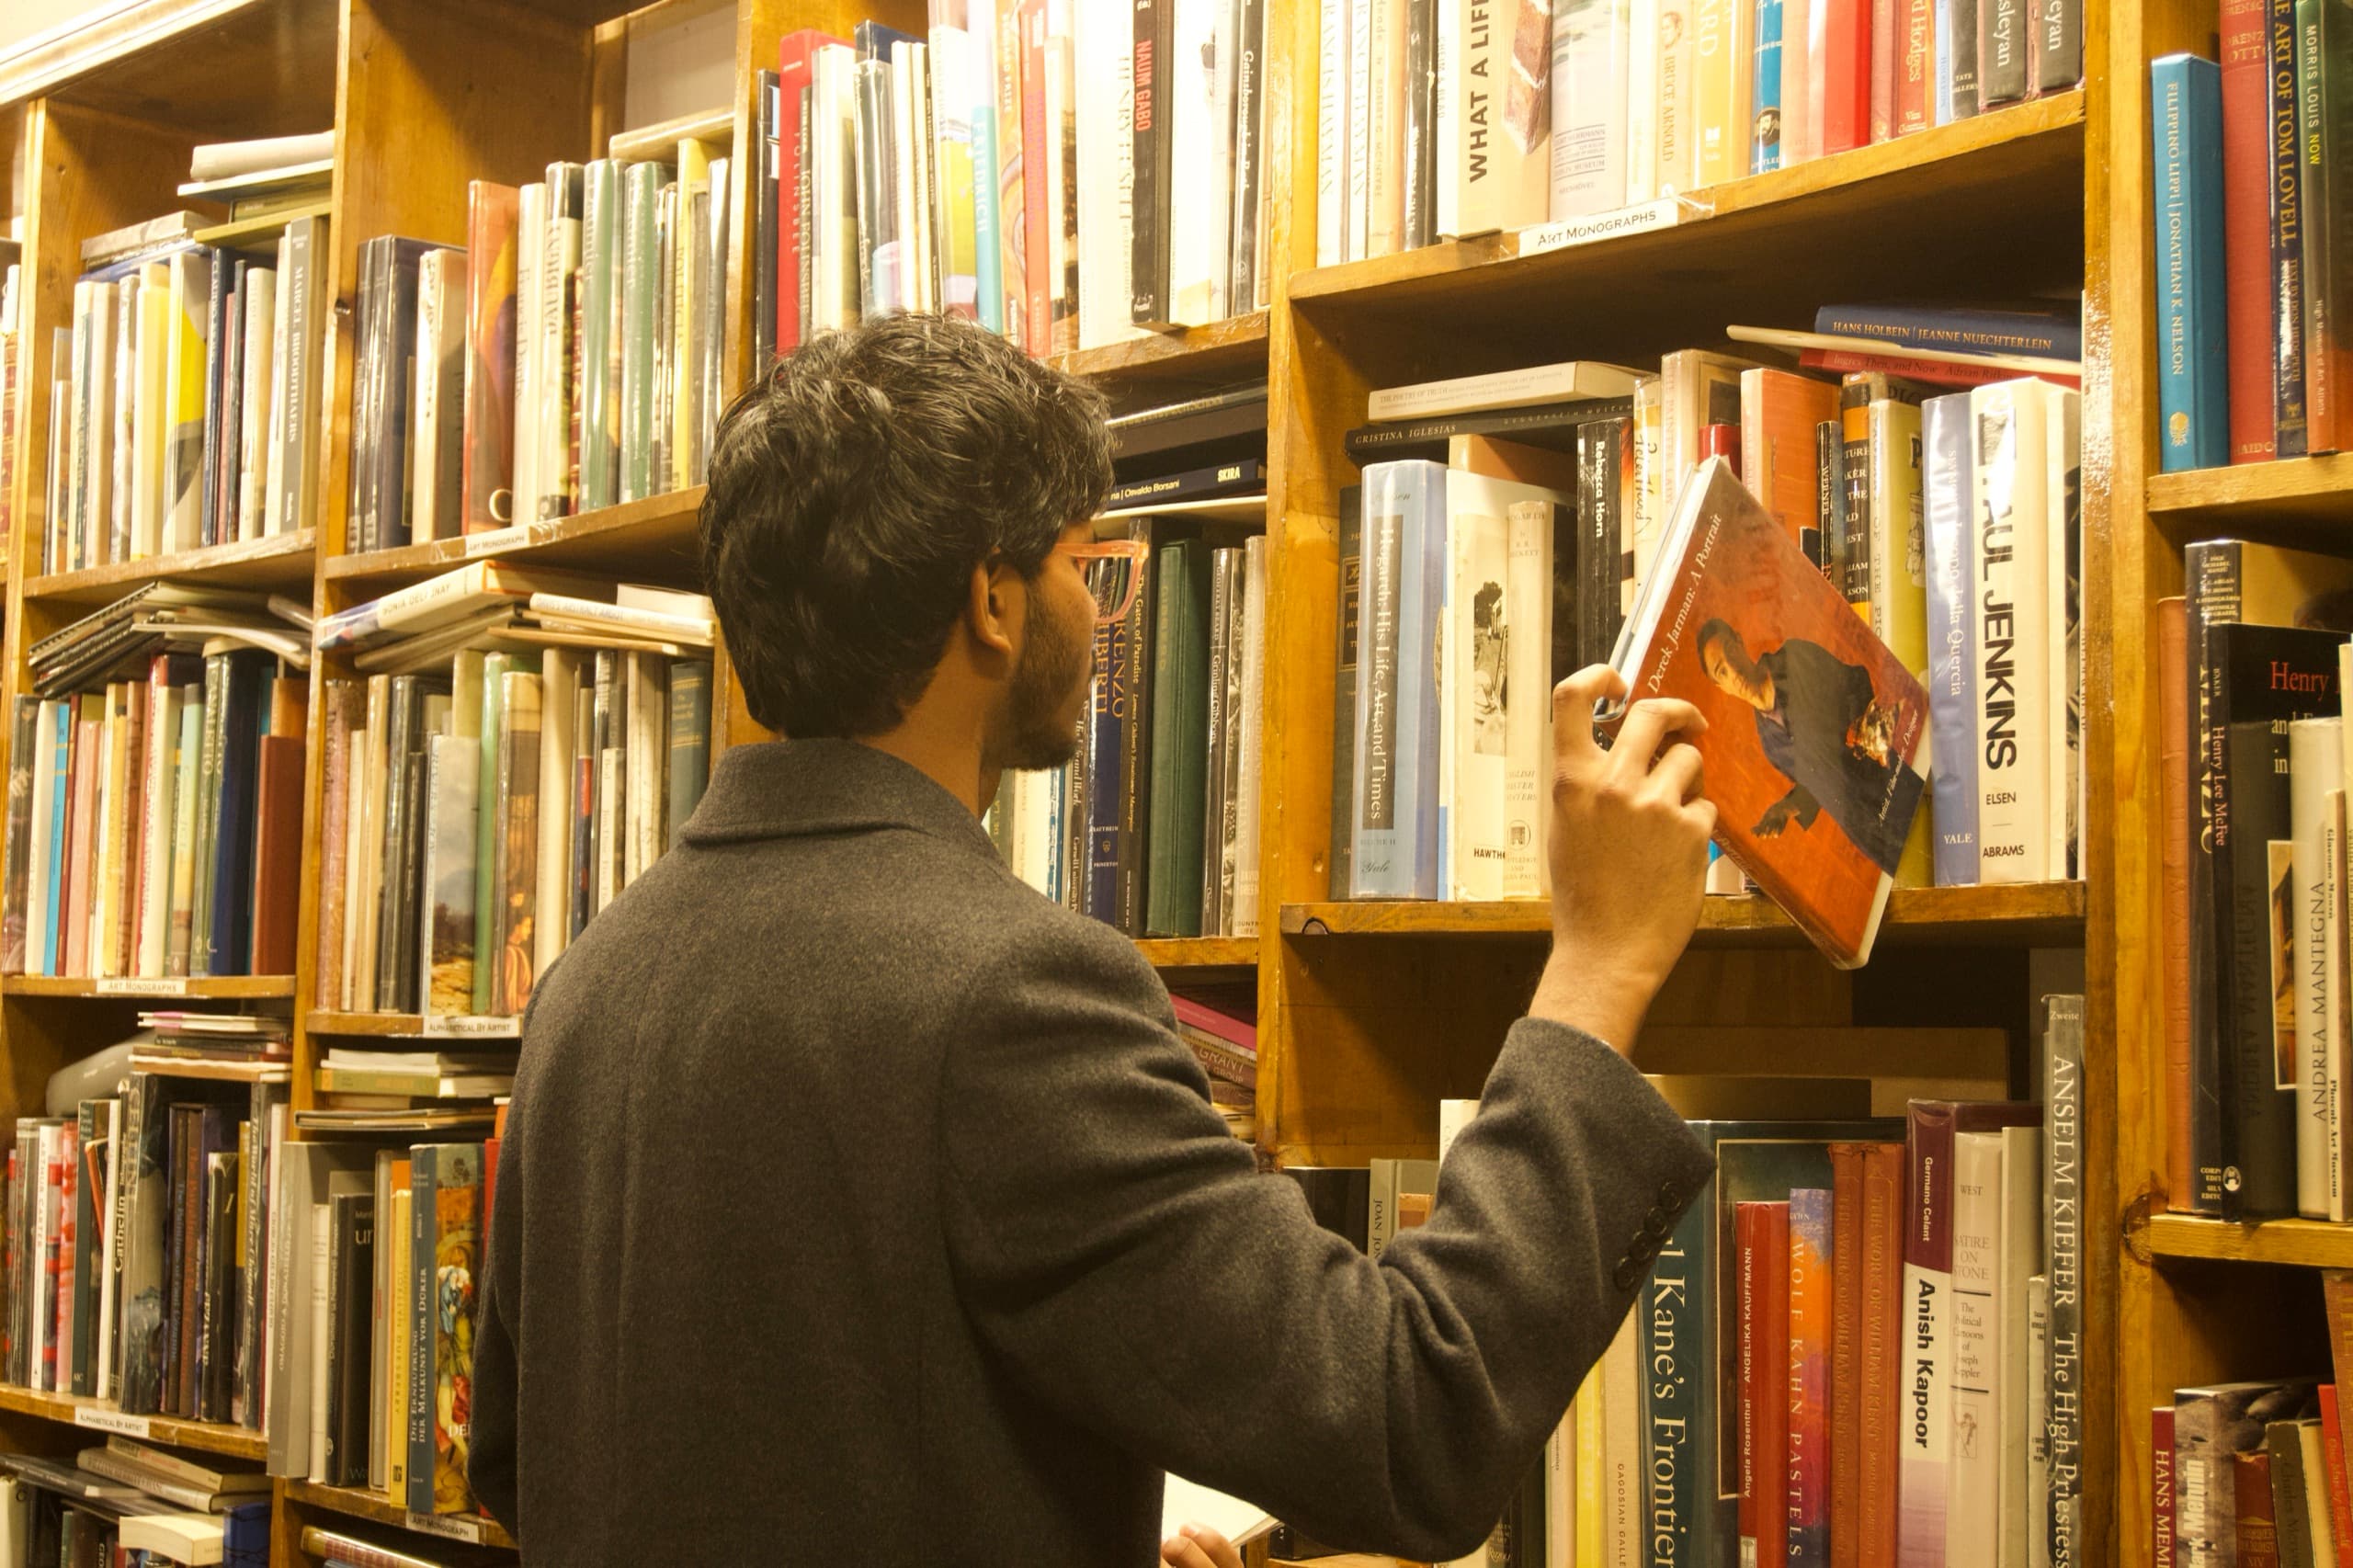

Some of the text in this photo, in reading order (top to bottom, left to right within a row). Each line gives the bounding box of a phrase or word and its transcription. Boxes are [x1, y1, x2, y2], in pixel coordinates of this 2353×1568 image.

[1135, 39, 1153, 132] NAUM GABO
[1470, 56, 1489, 78] A
[2305, 25, 2321, 165] MORRIS LOUIS NOW
[1469, 91, 1489, 184] WHAT
[1661, 55, 1677, 163] BRUCE ARNOLD
[2166, 81, 2182, 161] FILIPPINO
[2275, 22, 2298, 248] ART OF TOM LOVELL
[799, 168, 812, 217] JOHN
[972, 120, 989, 233] FRIEDRICH
[2168, 162, 2183, 200] LIPPI
[1538, 210, 1656, 246] ART MONOGRAPHS
[2167, 209, 2185, 301] JONATHAN
[1833, 321, 2052, 351] HANS HOLBEIN JEANNE NUECHTERLEIN
[2171, 314, 2187, 376] NELSON
[1354, 424, 1457, 444] CRISTINA IGLESIAS
[1124, 479, 1181, 497] Osvaldo Borsani
[1216, 466, 1241, 483] SKIRA
[1595, 439, 1608, 540] Rebecca Horn
[1376, 610, 1392, 640] His
[1646, 645, 1674, 696] Derek
[1665, 586, 1698, 652] Jarman:
[1694, 510, 1724, 571] Portrait
[1131, 643, 1143, 684] Paradise
[1983, 589, 2018, 771] JENKINS
[2268, 659, 2329, 703] Henry
[1370, 760, 1387, 821] Times
[1985, 791, 2018, 806] ELSEN
[1942, 833, 1973, 846] YALE
[1983, 844, 2026, 860] ABRAMS
[2308, 881, 2327, 1123] ANDREA MANTEGNA
[2052, 1053, 2076, 1187] ANSELM
[1374, 1199, 1383, 1233] JOAN
[1921, 1155, 1934, 1243] Germano Celant
[1960, 1185, 1985, 1196] WEST
[113, 1195, 125, 1273] Cathelin
[1960, 1250, 1980, 1264] ON
[2052, 1195, 2077, 1309] KIEFER
[417, 1315, 428, 1342] VOR
[1654, 1274, 1687, 1400] Kane's
[2053, 1331, 2079, 1383] The
[417, 1345, 428, 1415] MALKUNST
[1743, 1246, 1754, 1498] Angela Rosenthal ANGELIKA KAUFFMANN
[1911, 1278, 1937, 1449] Anish Kapoor
[410, 1417, 419, 1442] DIE
[417, 1417, 428, 1443] DER
[1789, 1243, 1805, 1557] WOLF KAHN PASTELS
[2047, 1388, 2080, 1454] High
[1617, 1462, 1627, 1526] GAGOSIAN
[2154, 1449, 2171, 1508] HANS
[2183, 1459, 2207, 1534] Mennin
